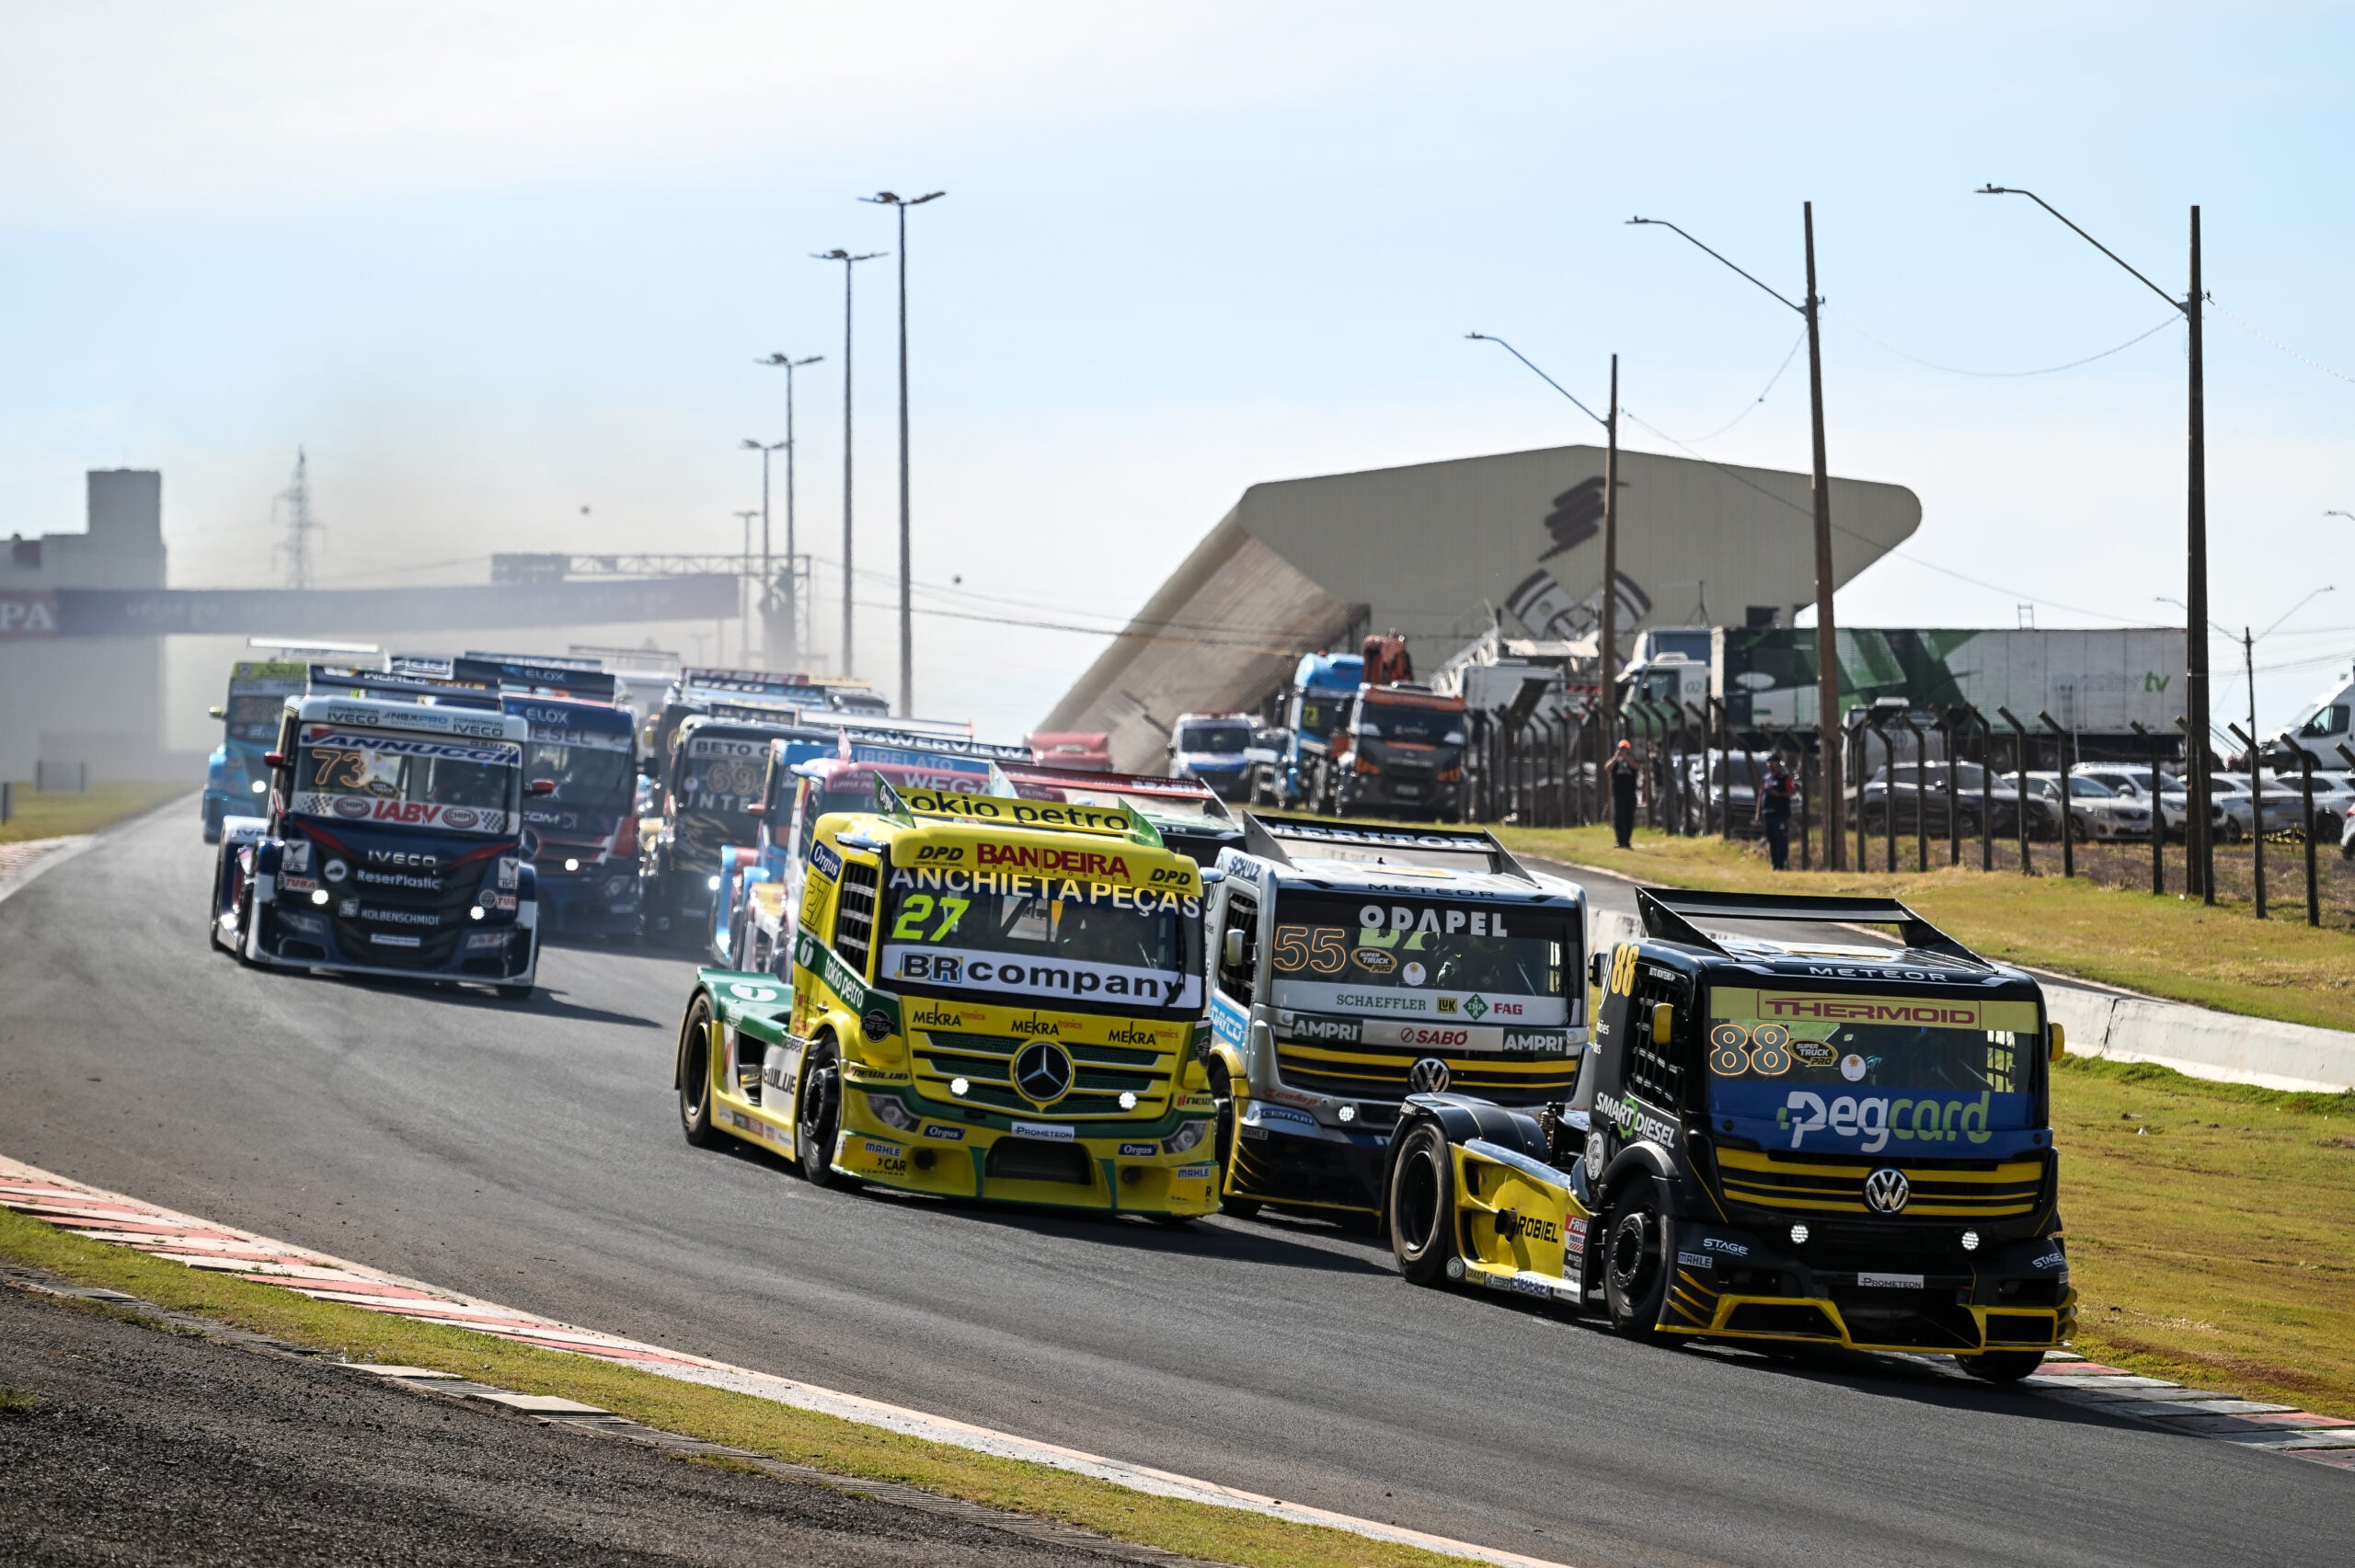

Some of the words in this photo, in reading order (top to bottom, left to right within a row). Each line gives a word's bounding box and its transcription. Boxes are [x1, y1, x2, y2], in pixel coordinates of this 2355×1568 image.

[524, 668, 566, 682] ELOX
[2144, 670, 2171, 692] tv
[327, 712, 379, 725] IVECO
[525, 707, 569, 724] ELOX
[454, 724, 503, 736] IVECO
[695, 740, 752, 756] BETO
[847, 729, 1025, 759] POWERVIEW
[856, 750, 954, 770] IBRELATO
[312, 750, 366, 788] 73
[1012, 804, 1130, 830] petro
[368, 848, 436, 865] IVECO
[812, 844, 839, 876] Orgus
[916, 845, 964, 862] DPD
[976, 842, 1132, 880] BANDEIRA
[978, 864, 1132, 884] TRANSPORTES
[1150, 868, 1191, 886] DPD
[1228, 855, 1262, 882] SCHULZ
[284, 877, 317, 890] TURA
[356, 869, 441, 890] ReserPlastic
[888, 867, 1083, 903] ANCHIETA
[1090, 881, 1200, 919] PEÇAS
[1368, 883, 1496, 898] METEOR
[361, 907, 441, 926] KOLBENSCHMIDT
[891, 894, 971, 942] 27
[1359, 904, 1508, 937] ODAPEL
[1271, 924, 1347, 973] 55
[1359, 951, 1376, 959] SUPER
[1362, 956, 1390, 965] TRUCK
[1372, 965, 1392, 973] PRO
[1611, 943, 1640, 998] 88
[1809, 967, 1948, 982] METEOR
[823, 955, 843, 989] tokio
[840, 976, 864, 1009] petro
[902, 953, 962, 983] BR
[967, 959, 1186, 1008] company
[1336, 994, 1427, 1011] SCHAEFFLER
[1494, 1002, 1523, 1015] FAG
[913, 1001, 962, 1027] MEKRA
[1764, 999, 1975, 1024] THERMOID
[1011, 1011, 1060, 1036] MEKRA
[1058, 1019, 1083, 1030] tronics
[1292, 1019, 1358, 1041] AMPRI
[1108, 1021, 1156, 1046] MEKRA
[1155, 1029, 1179, 1038] tronics
[1503, 1036, 1564, 1052] AMPRI
[1709, 1023, 1791, 1076] 88
[1796, 1042, 1819, 1050] SUPER
[1799, 1047, 1830, 1058] TRUCK
[1809, 1057, 1832, 1066] PRO
[762, 1067, 797, 1096] EWLUB
[1262, 1109, 1315, 1125] CESTARI
[1594, 1092, 1635, 1127] SMART
[1634, 1112, 1675, 1149] DIESEL
[929, 1127, 959, 1139] Orgus
[1014, 1126, 1073, 1139] PROMETEON
[866, 1142, 902, 1157] MAHLE
[1123, 1145, 1153, 1156] Orgus
[1178, 1168, 1210, 1179] MAHLE
[1703, 1238, 1749, 1256] STAGE
[1678, 1252, 1712, 1268] MAHLE
[2032, 1253, 2062, 1268] STAGE
[1860, 1277, 1923, 1288] PROMETEON
